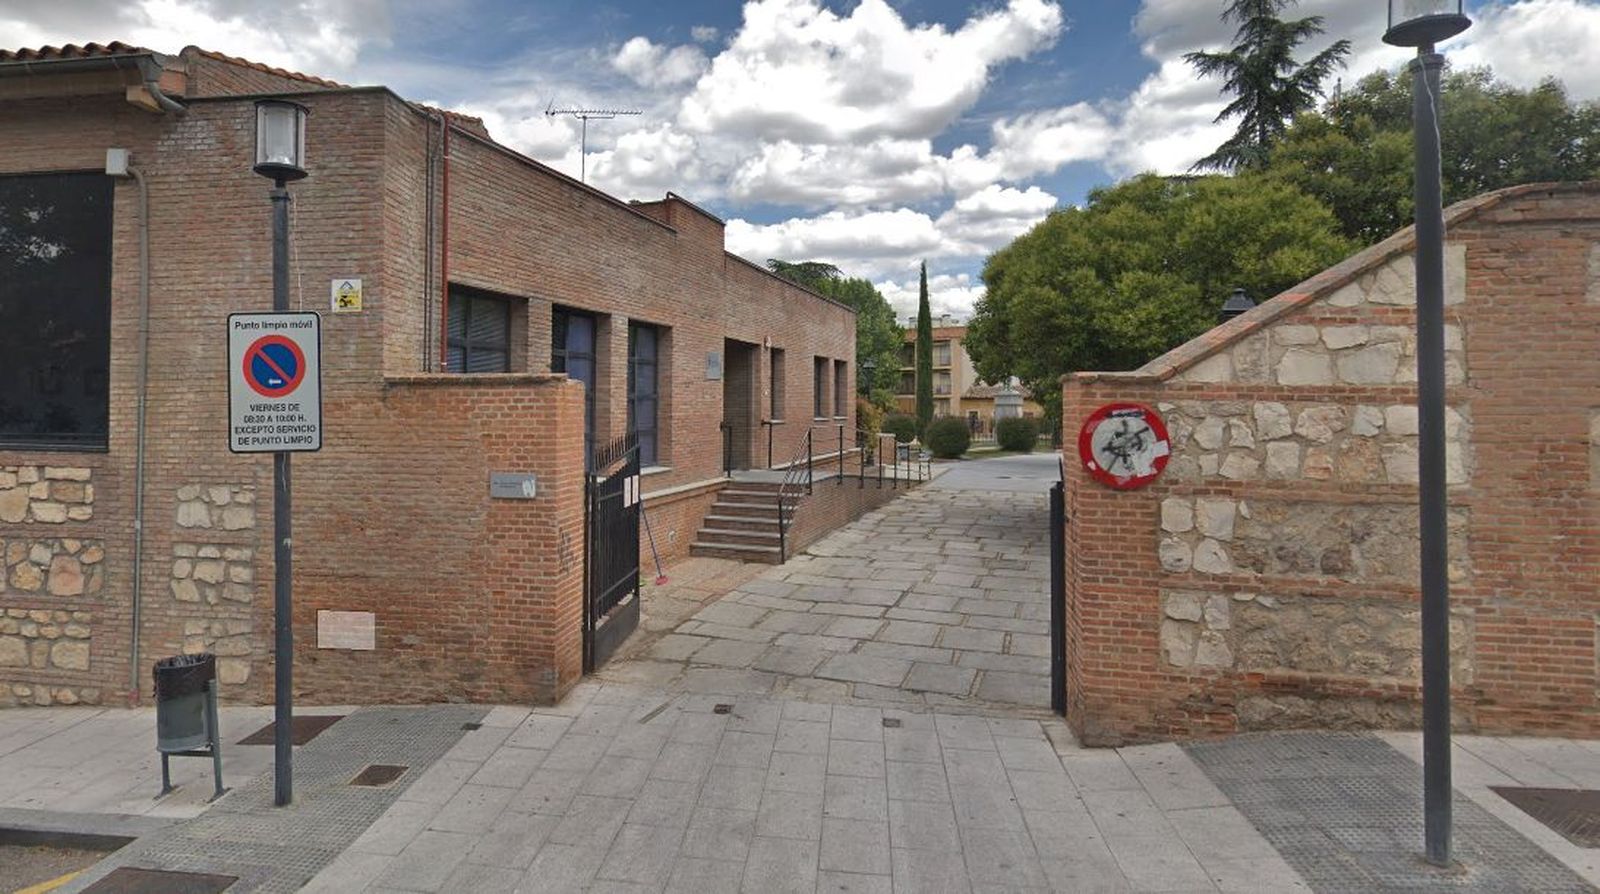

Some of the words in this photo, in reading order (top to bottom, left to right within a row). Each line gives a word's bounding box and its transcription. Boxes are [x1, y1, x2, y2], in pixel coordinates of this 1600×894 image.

[235, 321, 260, 330] Punto
[261, 320, 288, 330] limpio
[289, 320, 313, 329] móvil
[249, 403, 286, 412] VIERNES
[288, 403, 300, 411] DE
[298, 414, 307, 422] H.
[235, 425, 275, 434] EXCEPTO
[276, 425, 316, 434] SERVICIO
[238, 437, 250, 445] DE
[251, 436, 282, 445] PUNTO
[283, 435, 313, 444] LIMPIO
